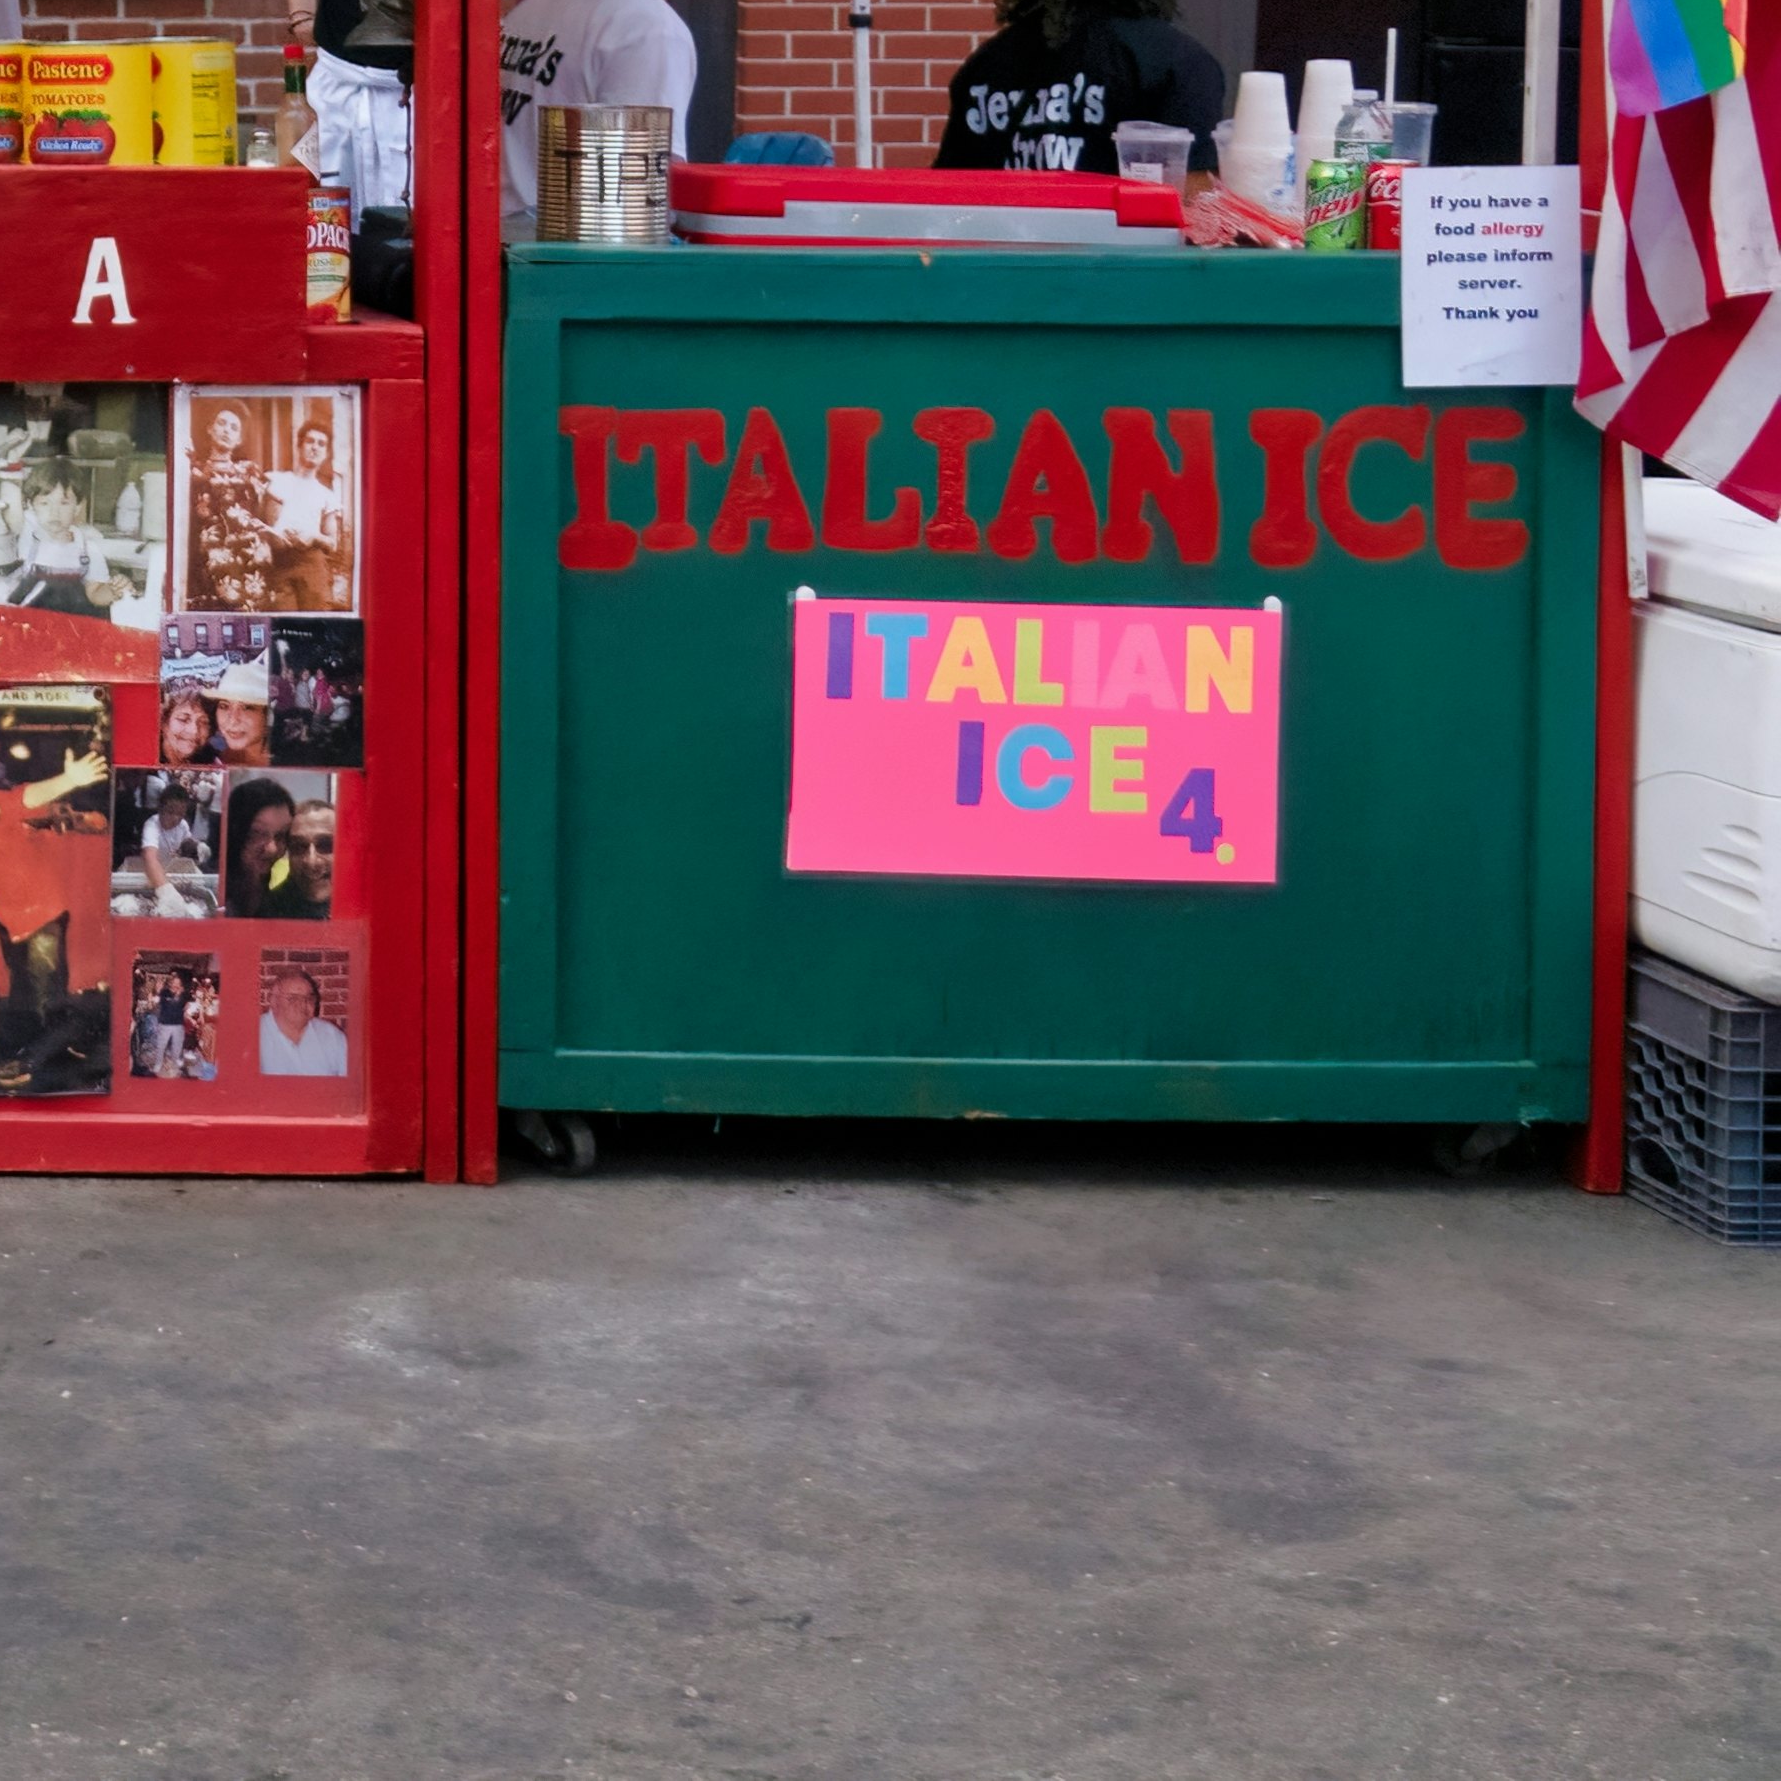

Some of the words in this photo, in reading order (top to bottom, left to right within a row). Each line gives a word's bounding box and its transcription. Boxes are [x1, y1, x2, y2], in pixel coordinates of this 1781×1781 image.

[32, 60, 104, 79] Pastene
[32, 94, 106, 105] TOMATOES
[40, 140, 70, 150] Kitchen
[71, 140, 100, 152] Ready
[1431, 195, 1442, 208] If
[1448, 198, 1481, 212] you
[1488, 195, 1531, 208] have
[1538, 197, 1549, 207] a
[1435, 223, 1474, 235] food
[1481, 222, 1544, 237] allergy
[1427, 250, 1487, 266] please
[1493, 249, 1553, 262] inform
[1458, 278, 1522, 289] server.
[1443, 307, 1500, 320] Thank
[1506, 308, 1539, 321] you
[557, 405, 1220, 570] ITALIAN
[1248, 404, 1529, 569] ICE
[826, 611, 1254, 714] ITALIAN
[957, 721, 1147, 814] ICE
